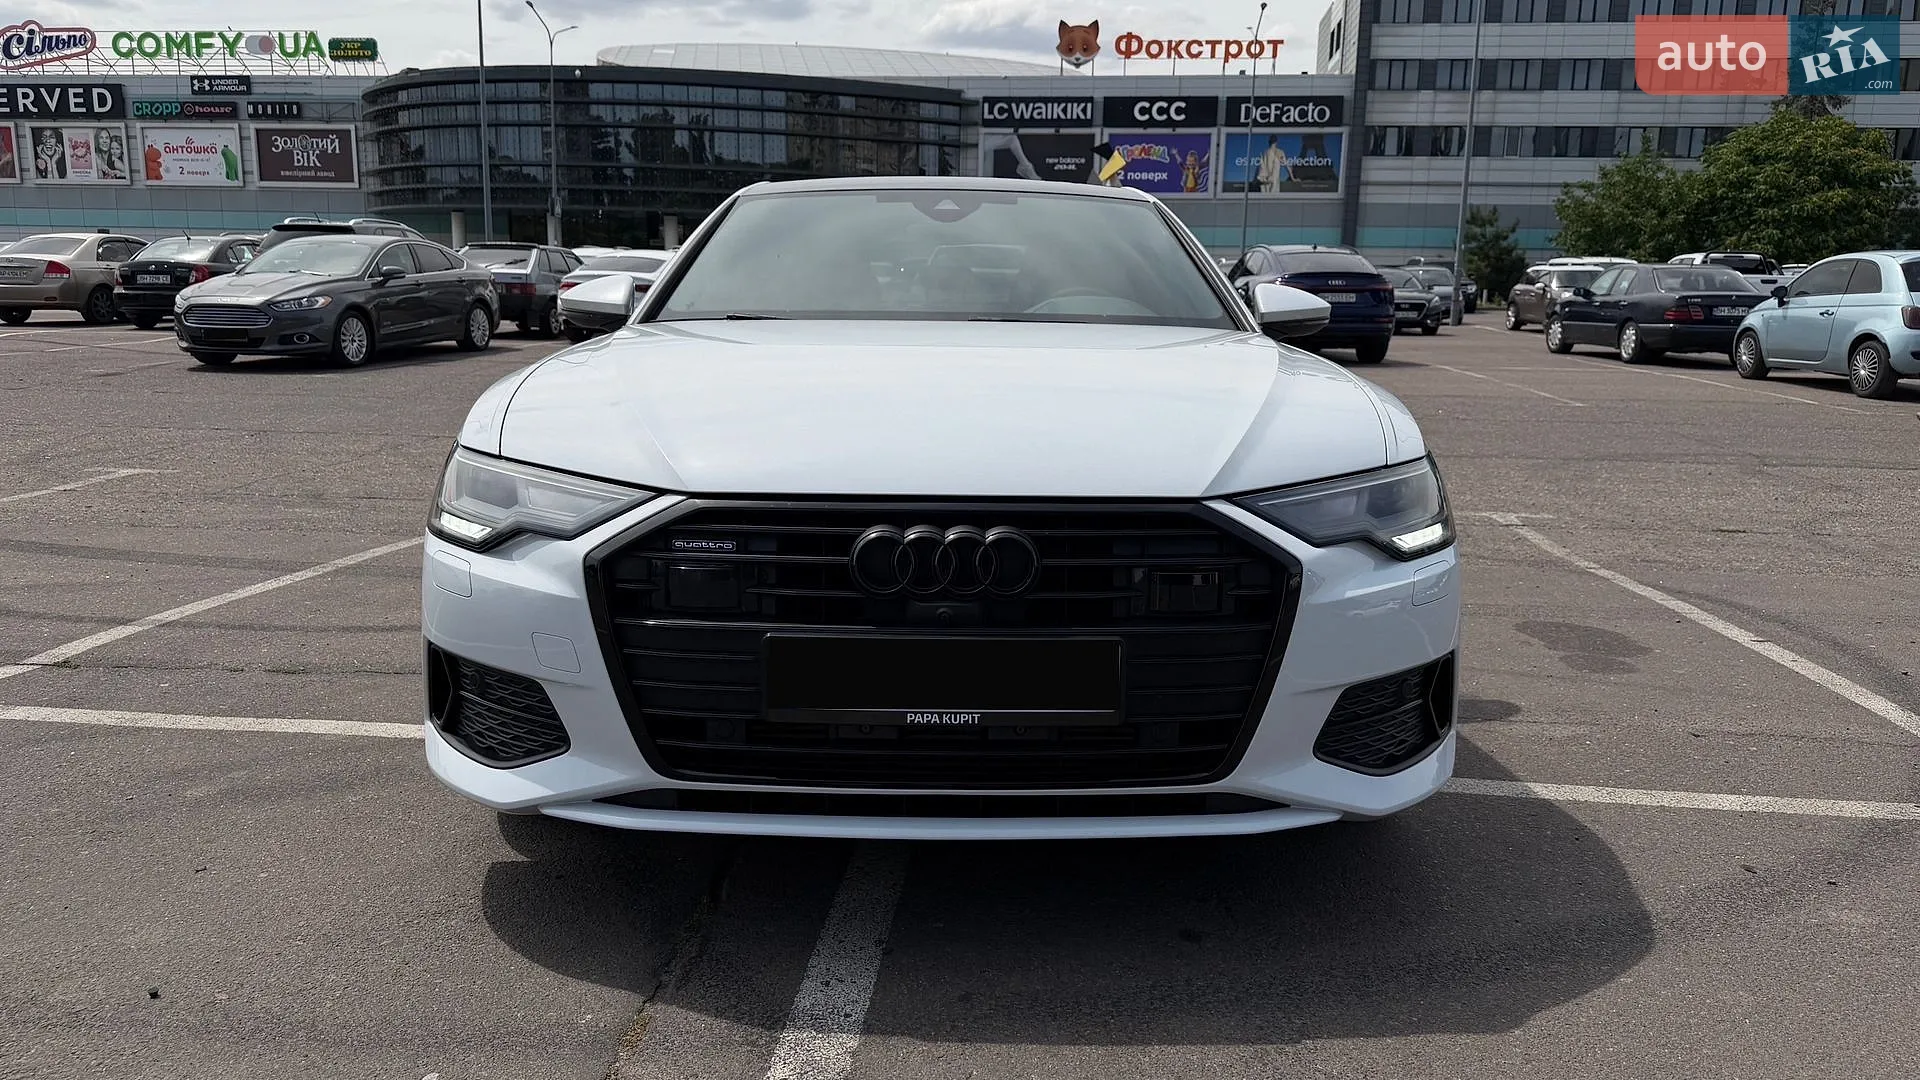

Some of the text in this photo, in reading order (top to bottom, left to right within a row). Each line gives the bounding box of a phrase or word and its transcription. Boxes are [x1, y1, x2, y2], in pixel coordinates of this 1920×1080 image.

[111, 31, 326, 59] COMFY UA
[1115, 32, 1284, 63] Фокстрот
[133, 103, 181, 116] CROPP
[983, 102, 1009, 120] LC
[1133, 101, 1187, 121] CCC
[1240, 102, 1331, 123] DeFacto
[179, 166, 185, 175] 2
[1117, 170, 1168, 182] 2 поверх
[674, 541, 733, 549] quattro
[906, 713, 981, 724] PAPA KUPIT
